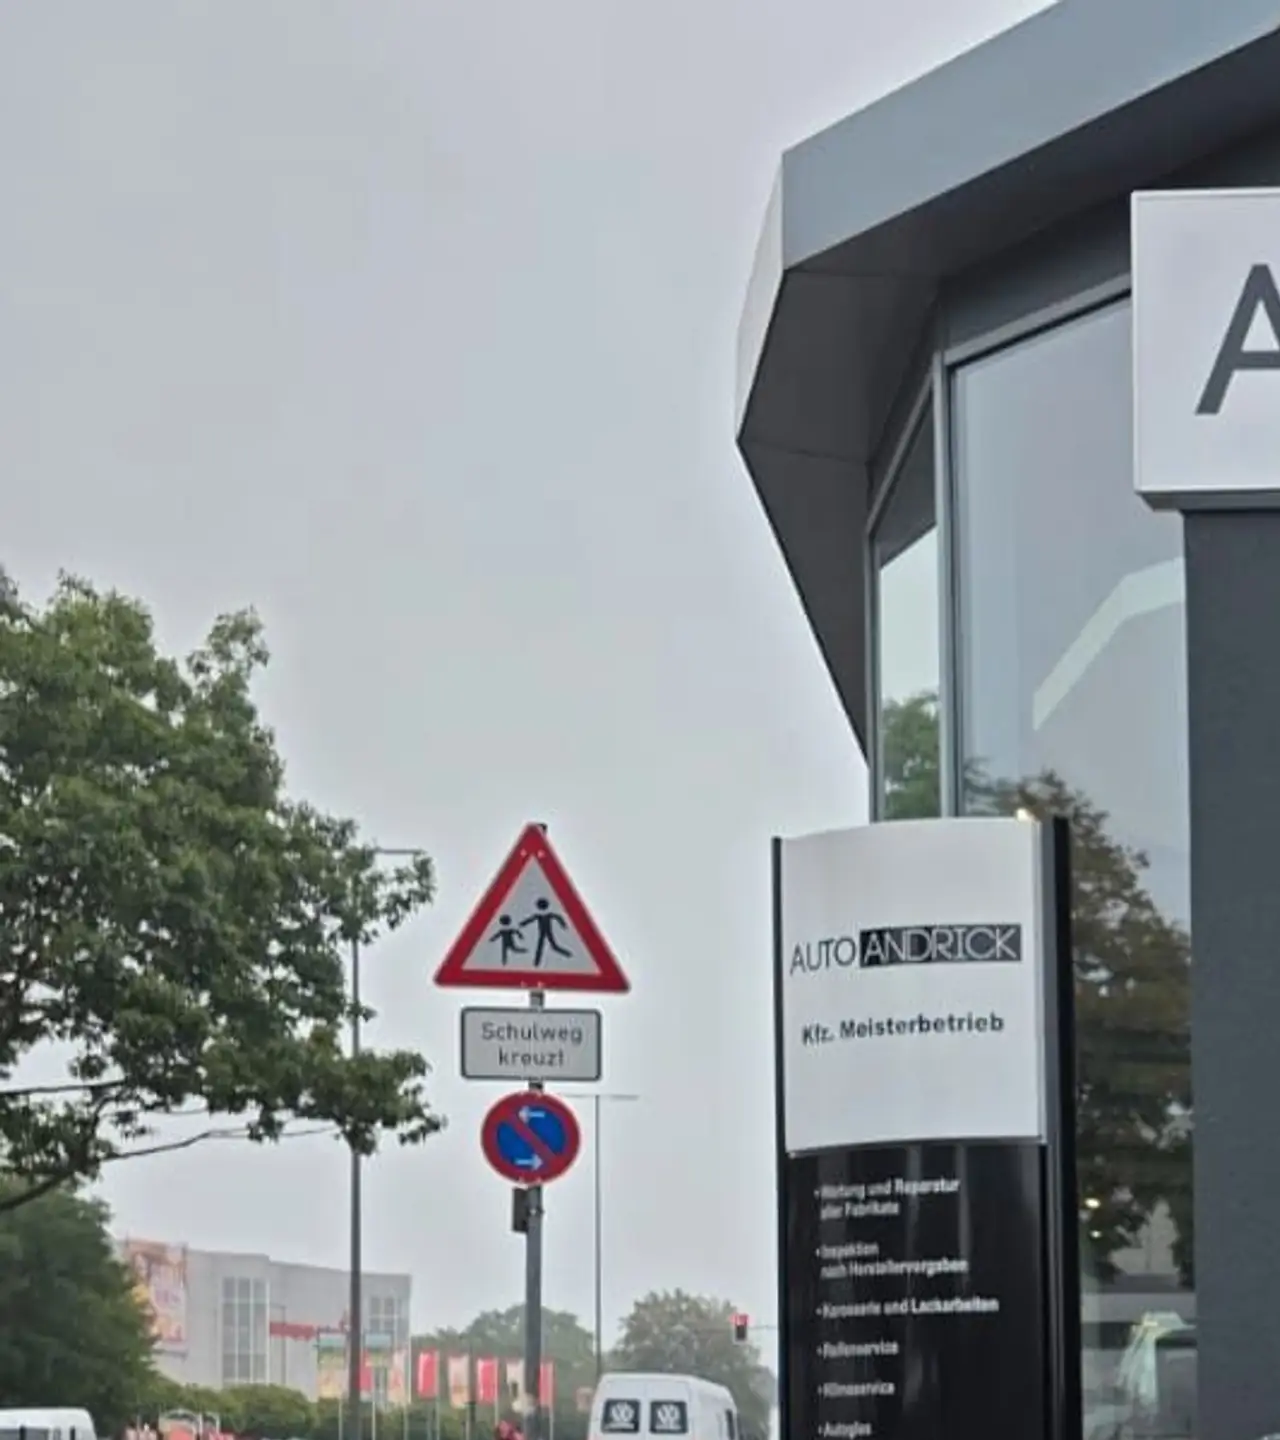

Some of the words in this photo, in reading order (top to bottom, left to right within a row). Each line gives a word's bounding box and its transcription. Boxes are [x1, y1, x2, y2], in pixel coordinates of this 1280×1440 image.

[789, 936, 856, 975] AUTO
[863, 926, 1018, 966] ANDRICK
[481, 1021, 583, 1045] Schulweg
[802, 1022, 834, 1046] Kfz.
[839, 1011, 1005, 1039] Meisterbetrieb
[498, 1047, 564, 1067] kreuzt
